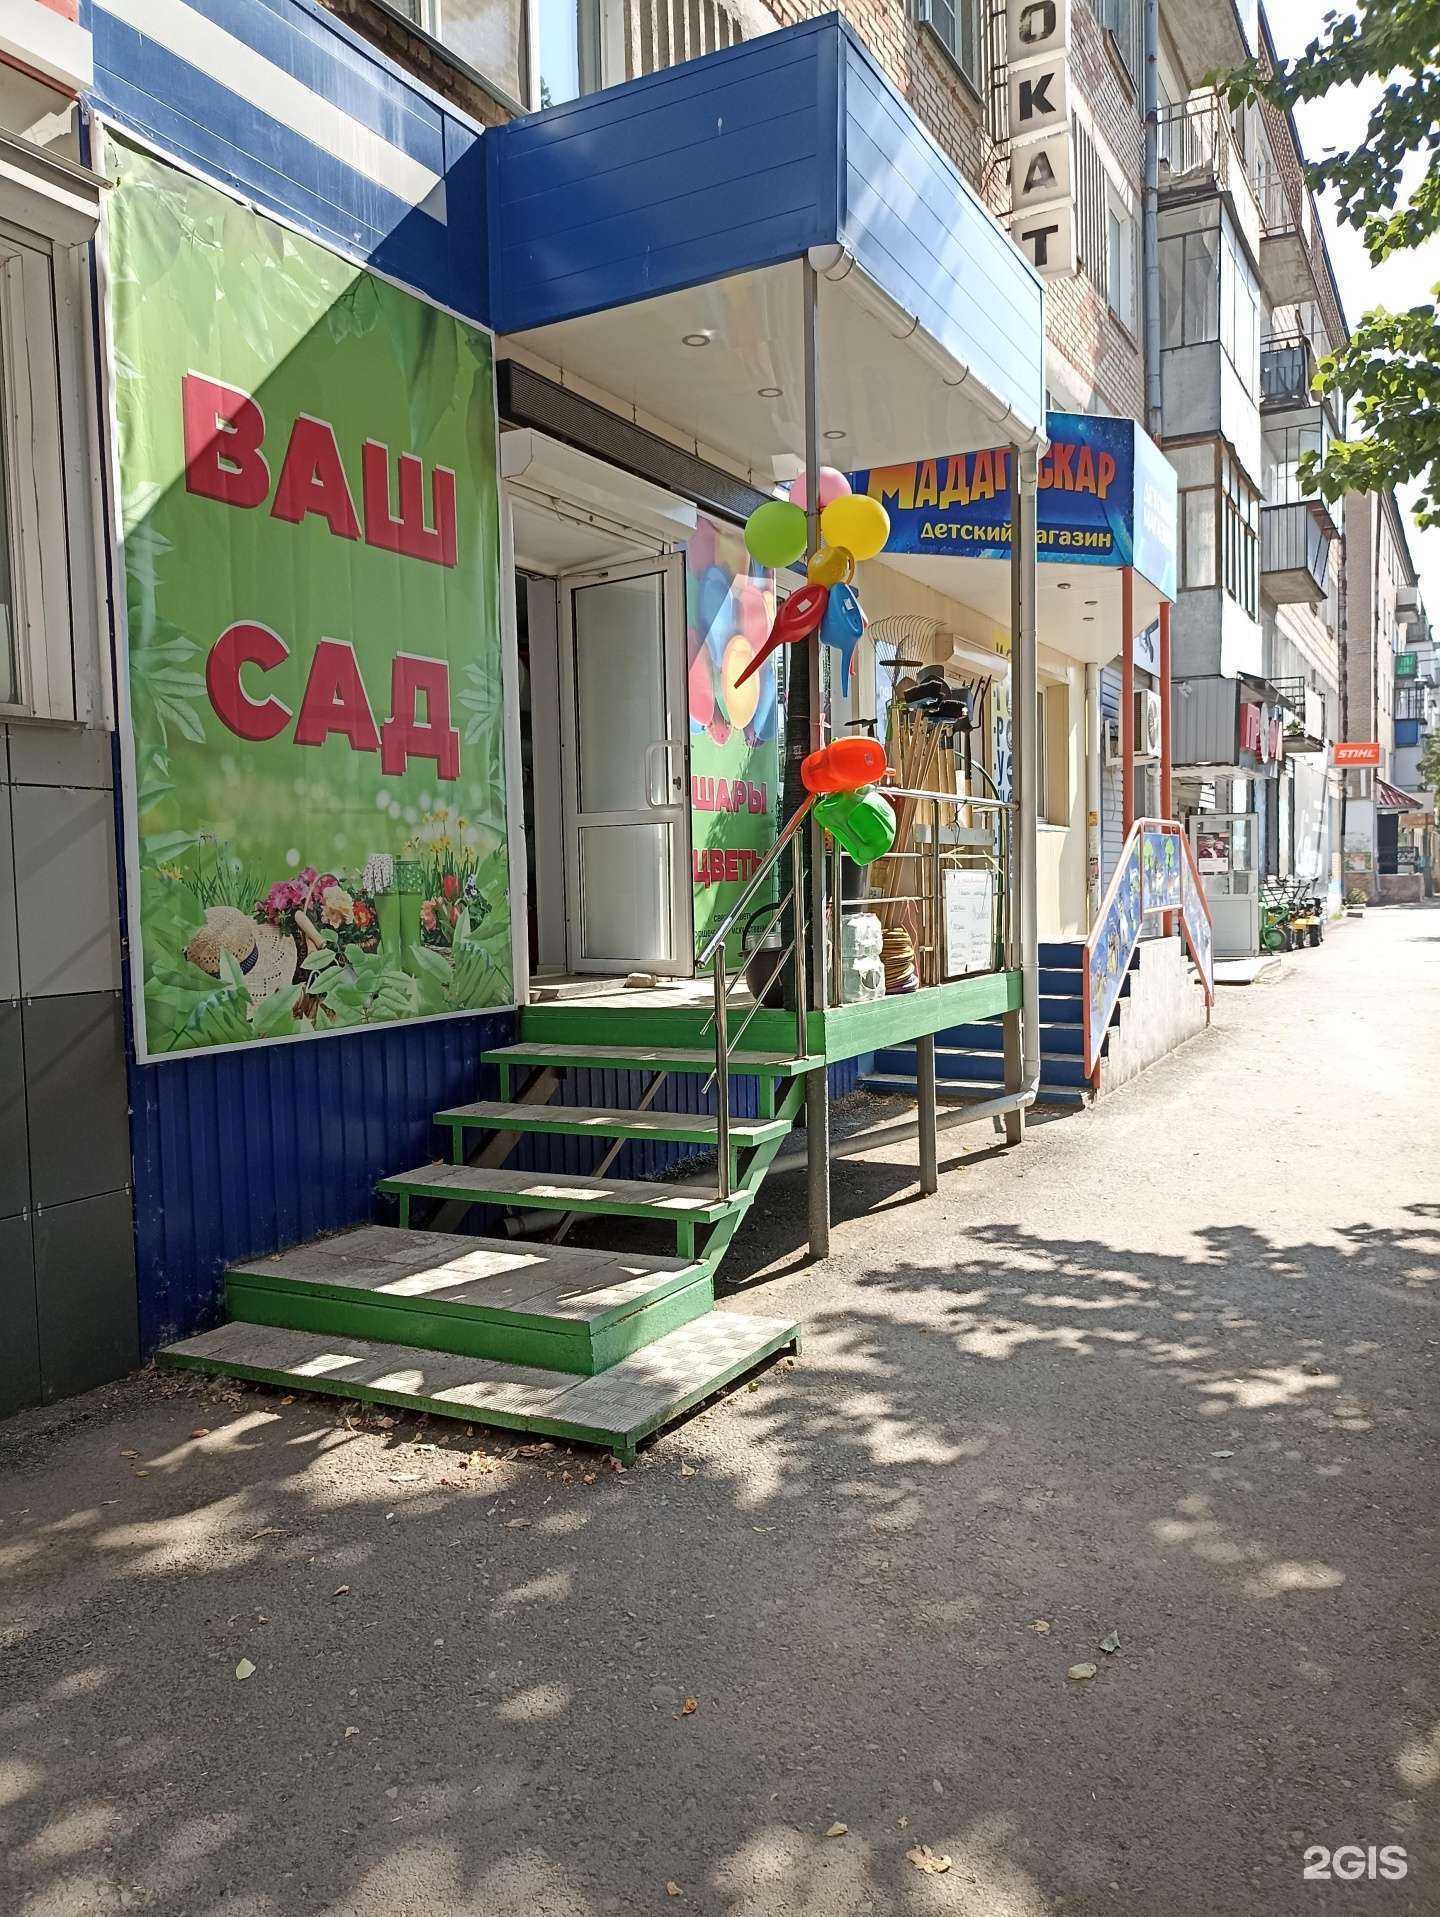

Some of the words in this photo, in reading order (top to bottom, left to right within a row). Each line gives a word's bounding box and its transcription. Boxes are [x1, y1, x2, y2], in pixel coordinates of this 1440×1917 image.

[182, 368, 459, 568] ВАШ
[867, 441, 1116, 509] МАДАГСКАР
[920, 521, 1012, 542] детский
[1036, 529, 1112, 548] агазин
[205, 619, 462, 781] САД
[1337, 749, 1376, 759] STIHL
[692, 774, 768, 815] ШАРЫ
